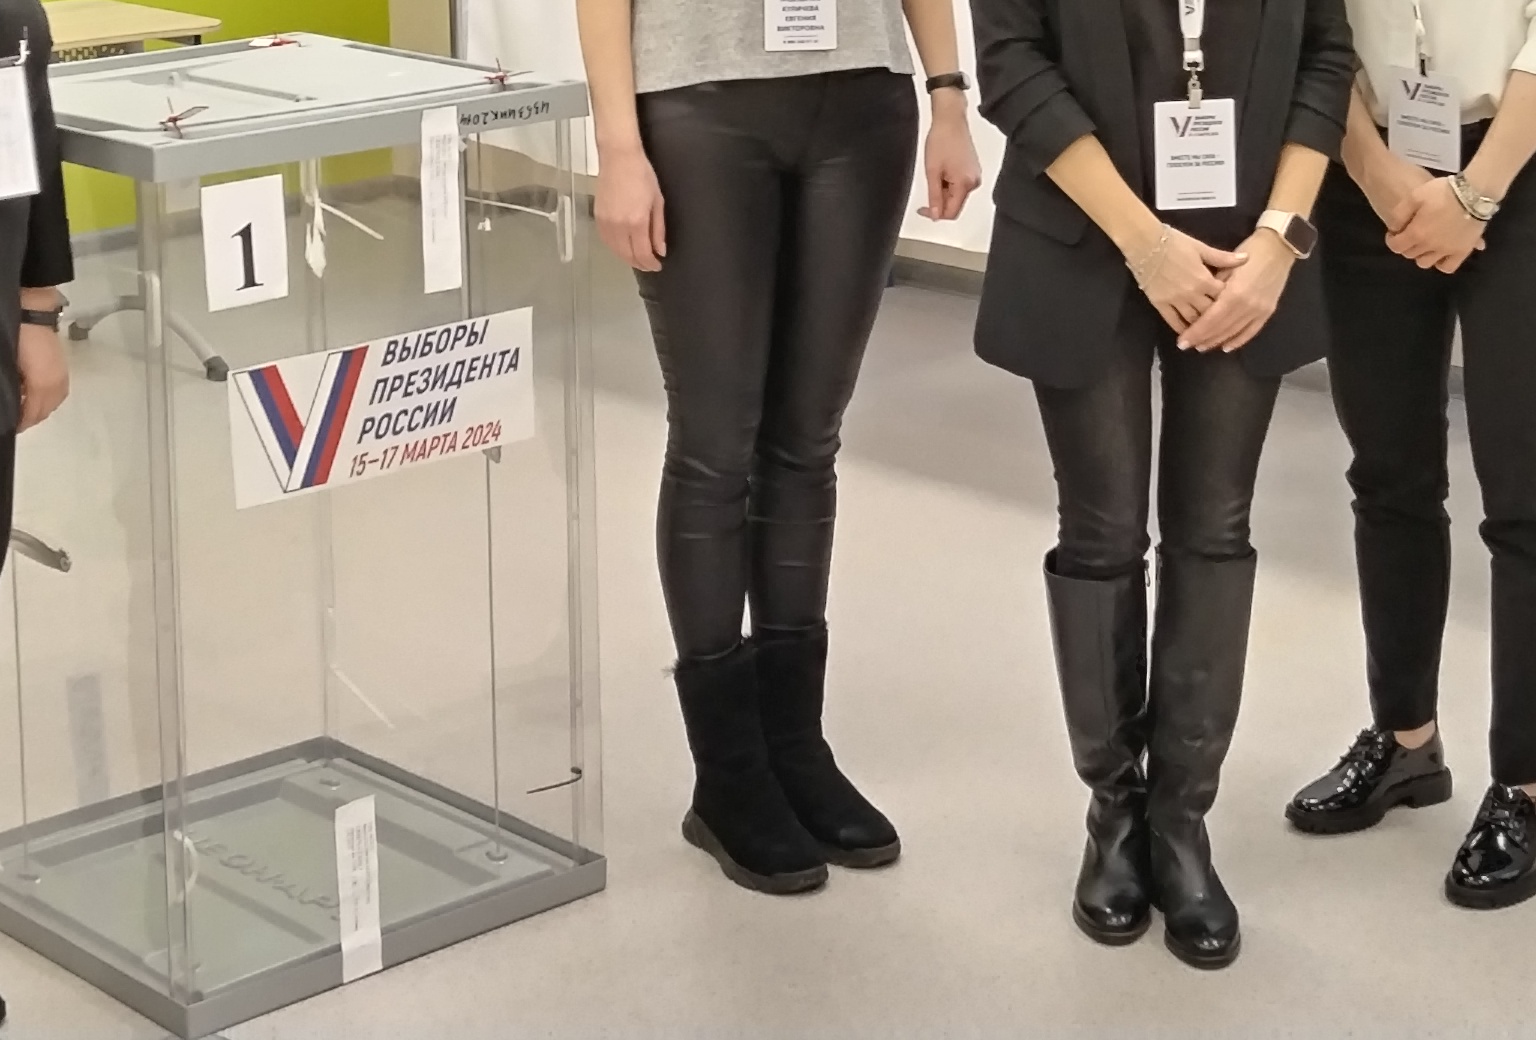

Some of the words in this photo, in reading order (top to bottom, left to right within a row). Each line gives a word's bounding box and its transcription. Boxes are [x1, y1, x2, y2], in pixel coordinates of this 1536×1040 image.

[230, 221, 265, 292] 1
[380, 318, 490, 367] ВЫБОРЫ
[368, 346, 521, 406] ПРЕЗИДЕНТА
[356, 396, 458, 445] РОССИИ
[399, 434, 458, 466] МАРТА
[461, 419, 502, 450] 2024
